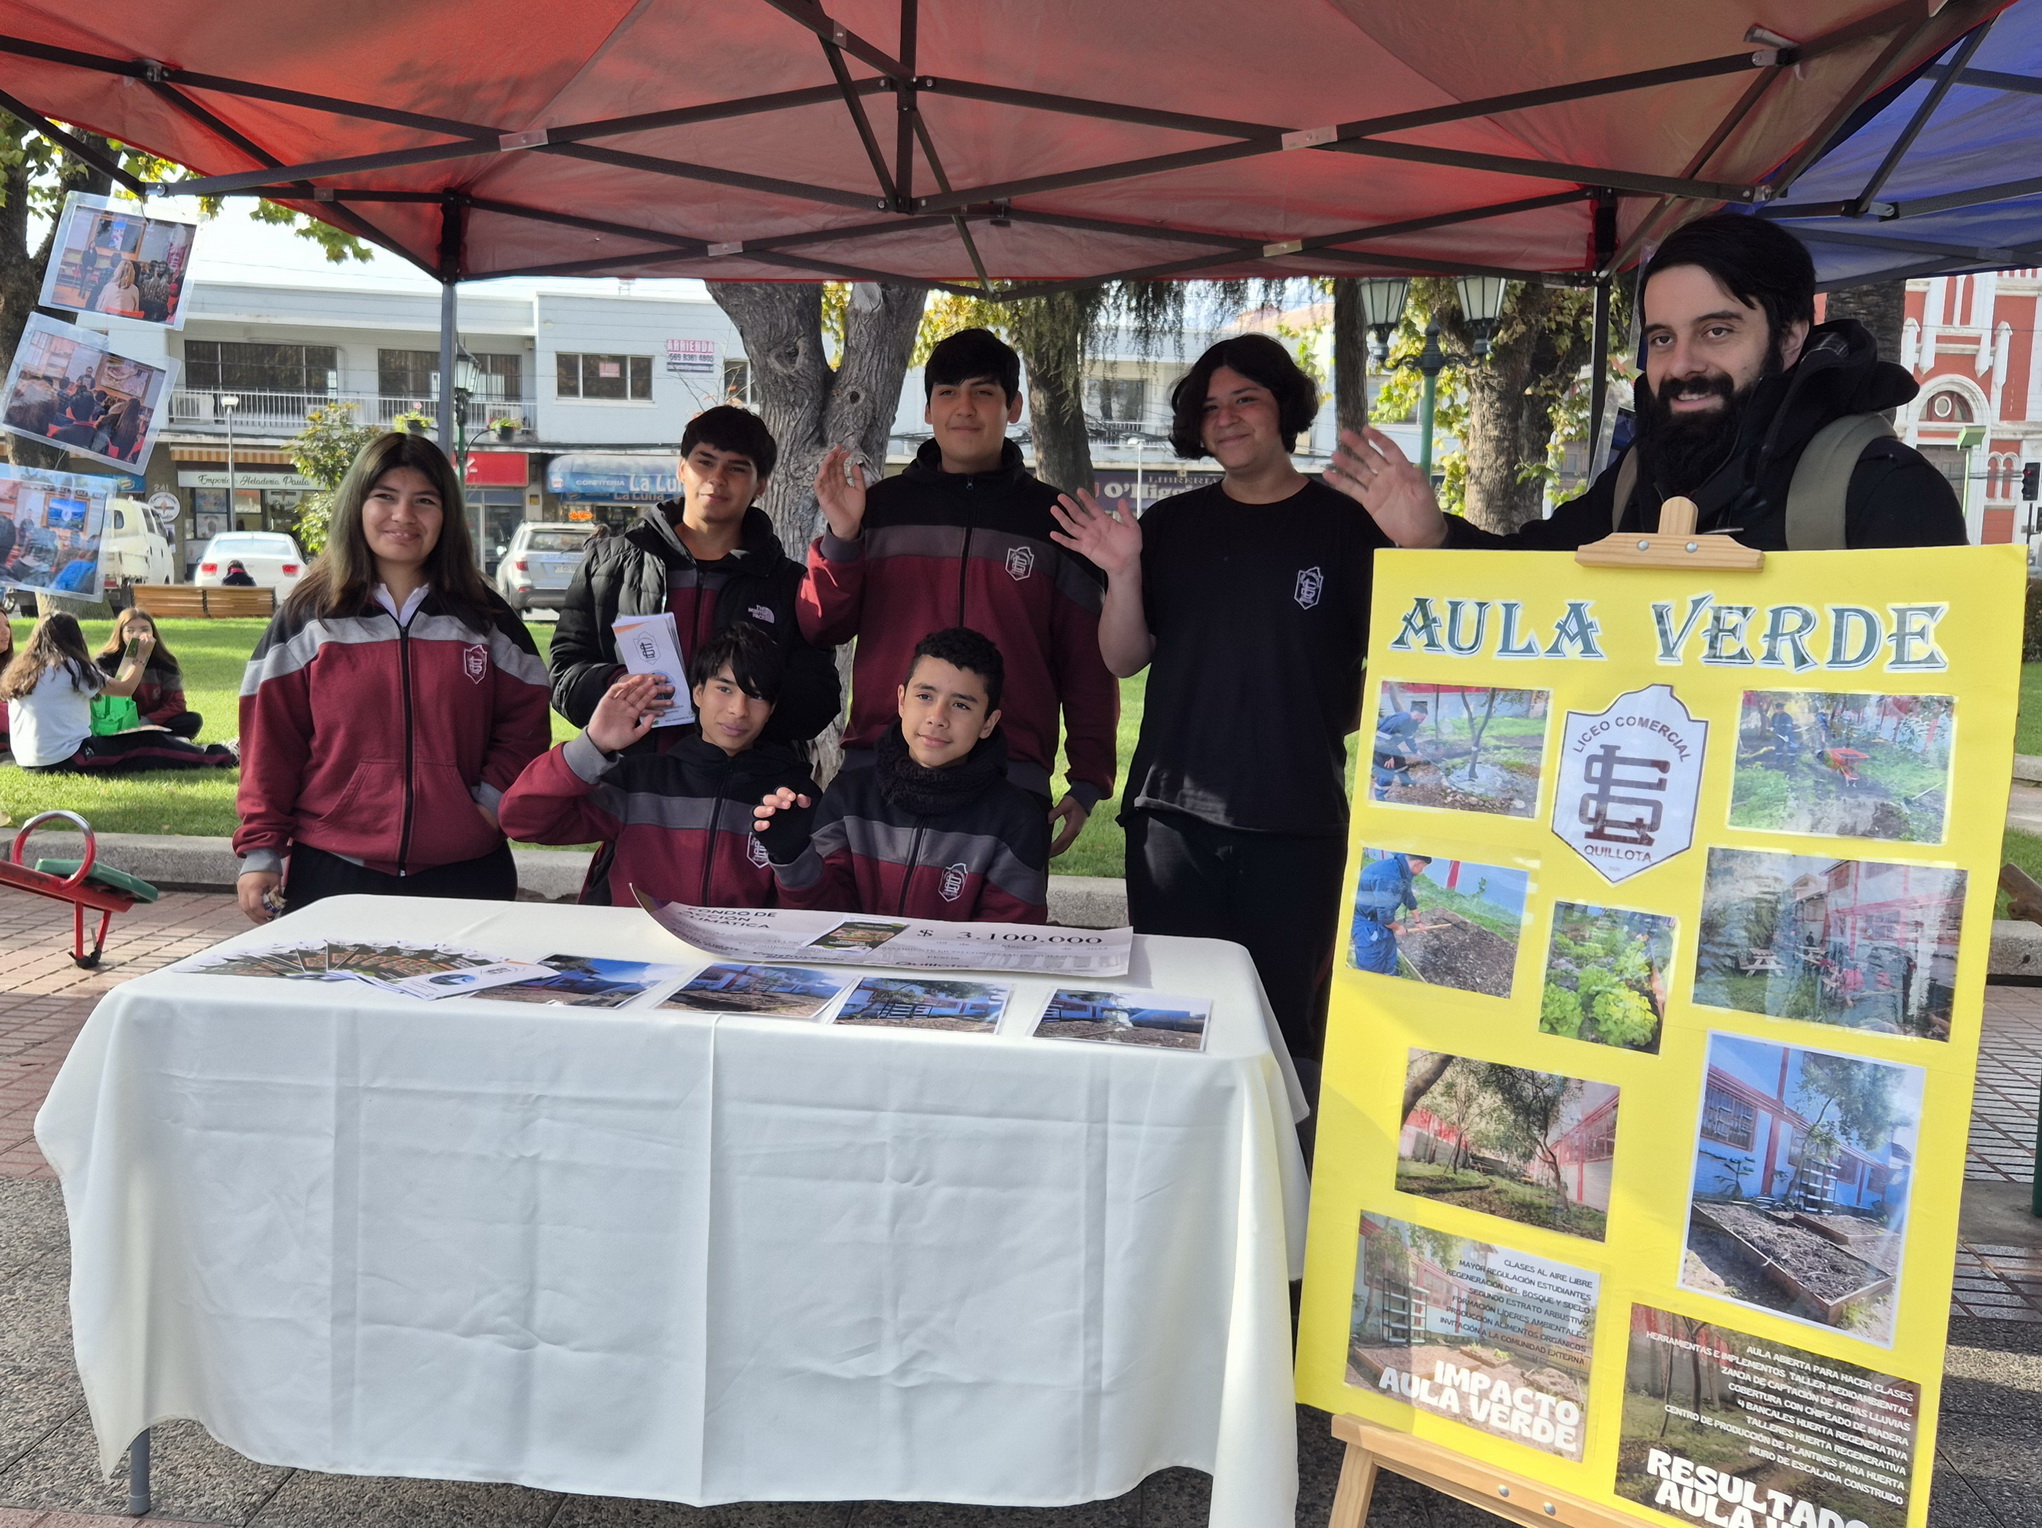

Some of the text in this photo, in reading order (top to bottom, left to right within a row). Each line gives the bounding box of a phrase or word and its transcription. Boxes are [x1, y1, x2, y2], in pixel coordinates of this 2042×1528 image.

[630, 474, 650, 492] La
[1390, 594, 1948, 672] AULA VERDE
[1573, 716, 1691, 762] LICEO COMERCIAL
[1584, 845, 1652, 862] QUILLOTA
[917, 929, 934, 937] $
[957, 931, 1102, 944] 3.100.000
[1446, 1269, 1503, 1290] REGENERACIÓN
[1505, 1285, 1519, 1294] DEL
[1522, 1290, 1553, 1304] BOSQUE
[1564, 1301, 1590, 1314] SUELO
[1460, 1260, 1591, 1301] MAYOR REGULACIÓN ESTUDIANTES
[1504, 1260, 1535, 1273] CLASES
[1550, 1272, 1567, 1282] AIRE
[1569, 1277, 1592, 1288] LIBRE
[1446, 1306, 1586, 1352] PRODUCCIÓN ALIMENTOS ORGÁNICOS
[1453, 1296, 1495, 1314] FORMACIÓN
[1497, 1307, 1529, 1324] LÍDERES
[1469, 1288, 1588, 1327] SEGUNDO ESTRATO ARBUSTIVO
[1440, 1317, 1584, 1365] INVITACIÓN A LA COMUNIDAD EXTERNA
[1434, 1360, 1579, 1426] IMPACTO
[1646, 1330, 1912, 1416] HERRAMIENTAS E IMPLEMENTOS TALLER MEDIOAMBIENTAL
[1747, 1346, 1913, 1402] AULA ABIERTA PARA HACER CLASES
[1378, 1366, 1577, 1452] AULA VERDE
[1728, 1382, 1909, 1446] COBERTURA CON CHIPEADO DE MADERA
[1753, 1376, 1766, 1386] DE
[1768, 1380, 1819, 1402] CAPTACIÓN
[1820, 1397, 1834, 1407] DE
[1835, 1401, 1868, 1418] AGUAS
[1869, 1411, 1911, 1432] LLUVIAS
[1665, 1404, 1905, 1490] CENTRO DE PRODUCCIÓN DE PLANTINES PARA HUERTA
[1738, 1399, 1908, 1462] 4 BANCALES HUERTA REGENERATIVA
[1746, 1415, 1906, 1476] TALLERES HUERTA REGENERATIVA
[1749, 1446, 1903, 1505] MURO DE ESCALADA CONSTRUIDO
[1655, 1480, 1755, 1528] AULA
